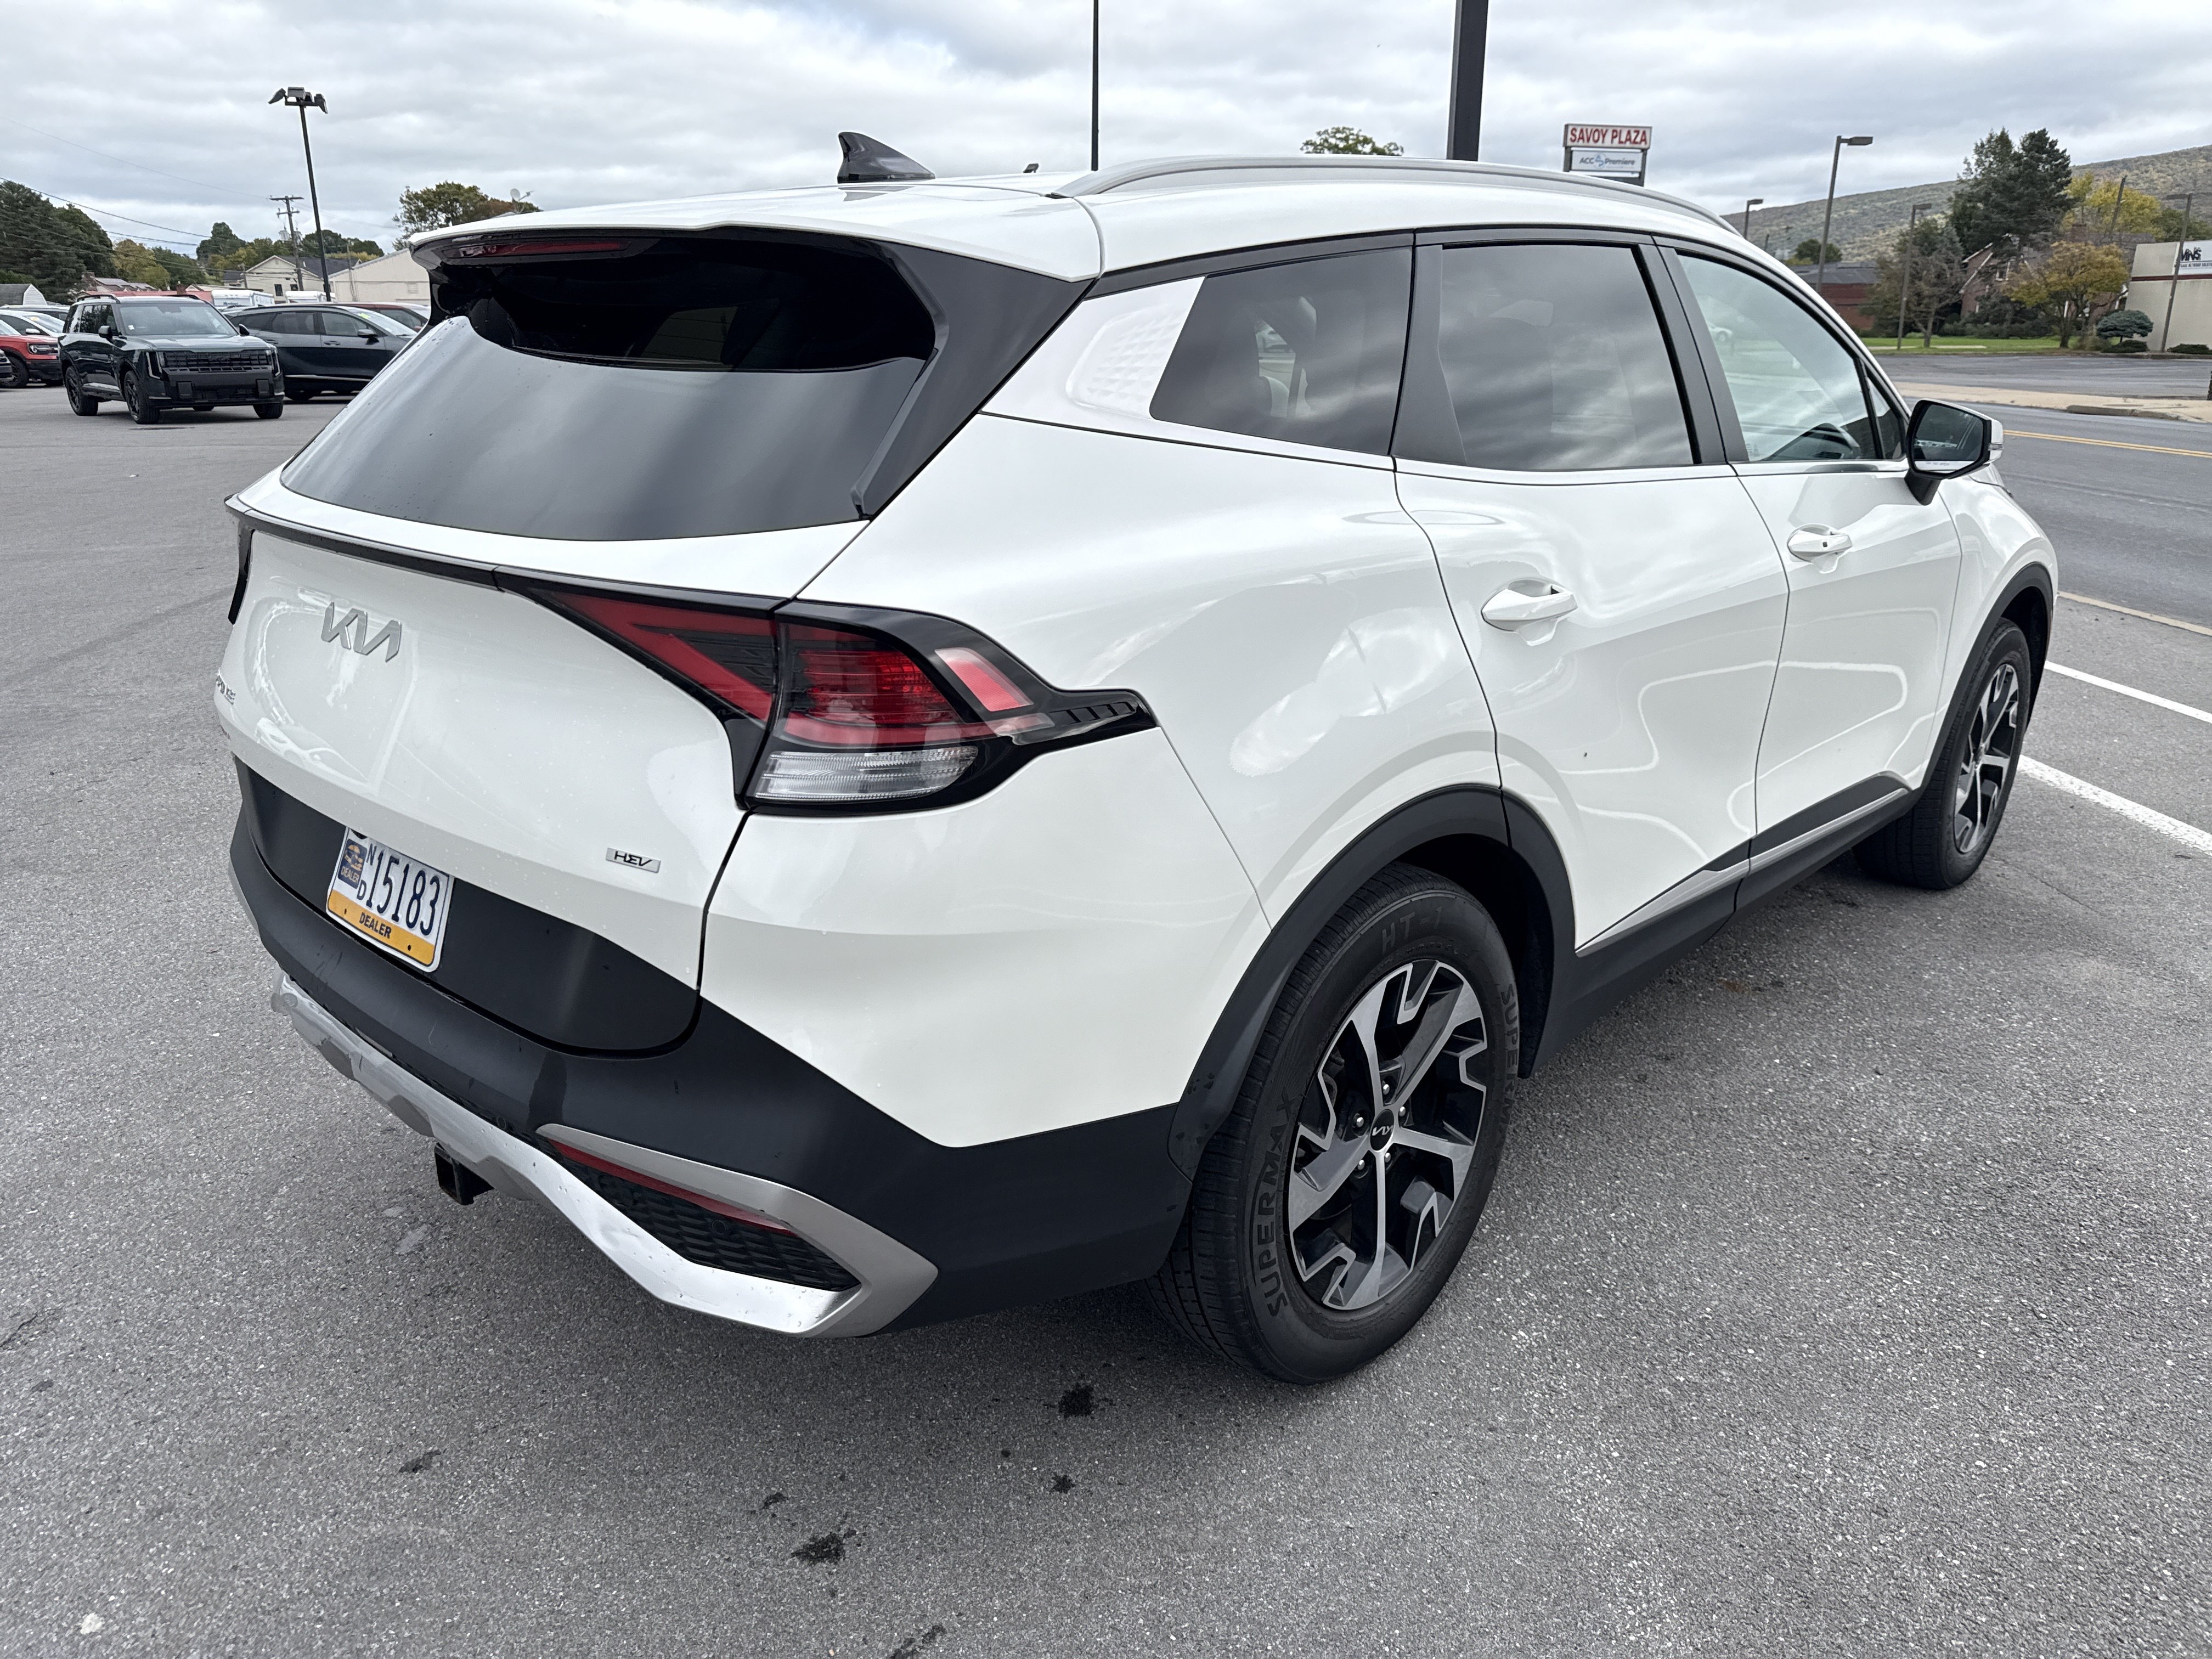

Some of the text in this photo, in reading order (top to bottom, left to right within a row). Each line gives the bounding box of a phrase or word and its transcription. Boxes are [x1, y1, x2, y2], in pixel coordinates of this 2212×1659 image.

[1570, 128, 1647, 145] SAVOY PLAZA
[614, 850, 653, 866] HEV
[365, 851, 441, 936] 15183
[359, 911, 392, 940] DEALER
[1257, 1086, 1296, 1317] SUPERMAX
